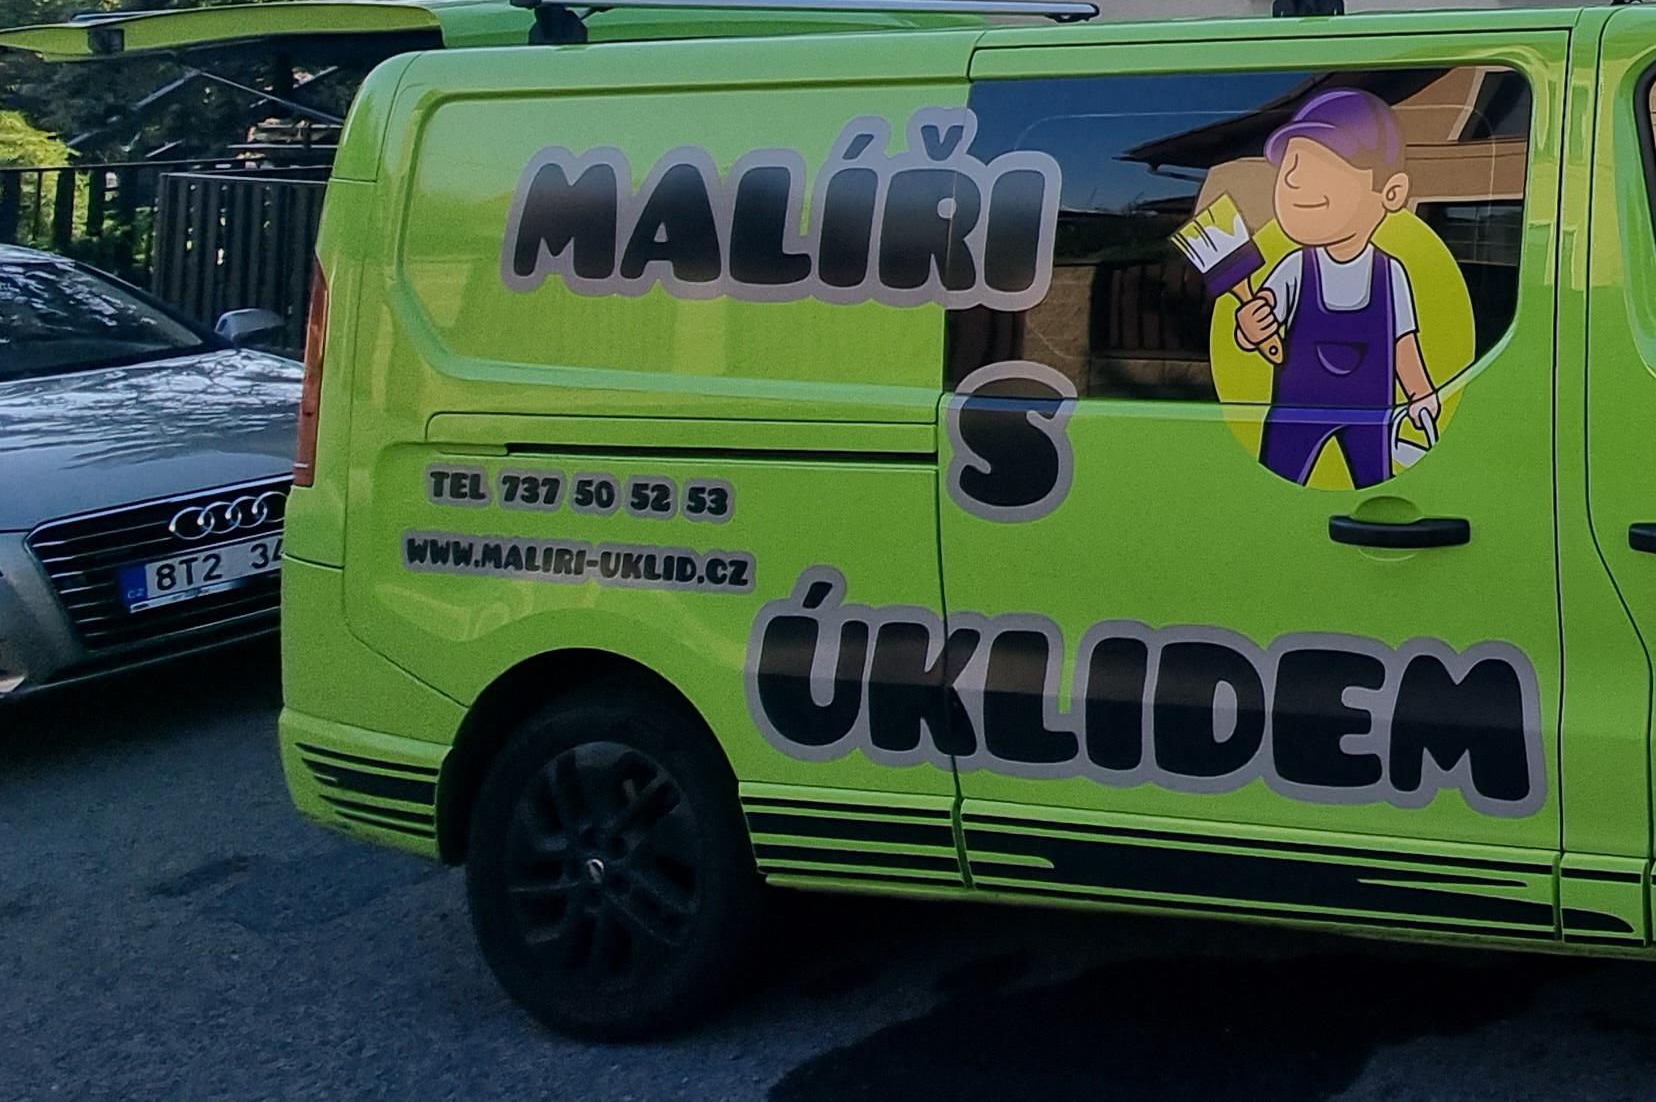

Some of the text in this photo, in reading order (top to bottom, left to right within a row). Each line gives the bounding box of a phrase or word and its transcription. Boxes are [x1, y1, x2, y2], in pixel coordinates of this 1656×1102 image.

[513, 124, 1046, 294] MALÍŘI
[958, 377, 1068, 508] S
[430, 471, 728, 516] TEL 737 50 52 53
[156, 553, 222, 591] 8T2
[406, 538, 749, 586] WWW.MALIRI-UKLID.CZ
[758, 581, 1532, 802] ÚKLIDEM
